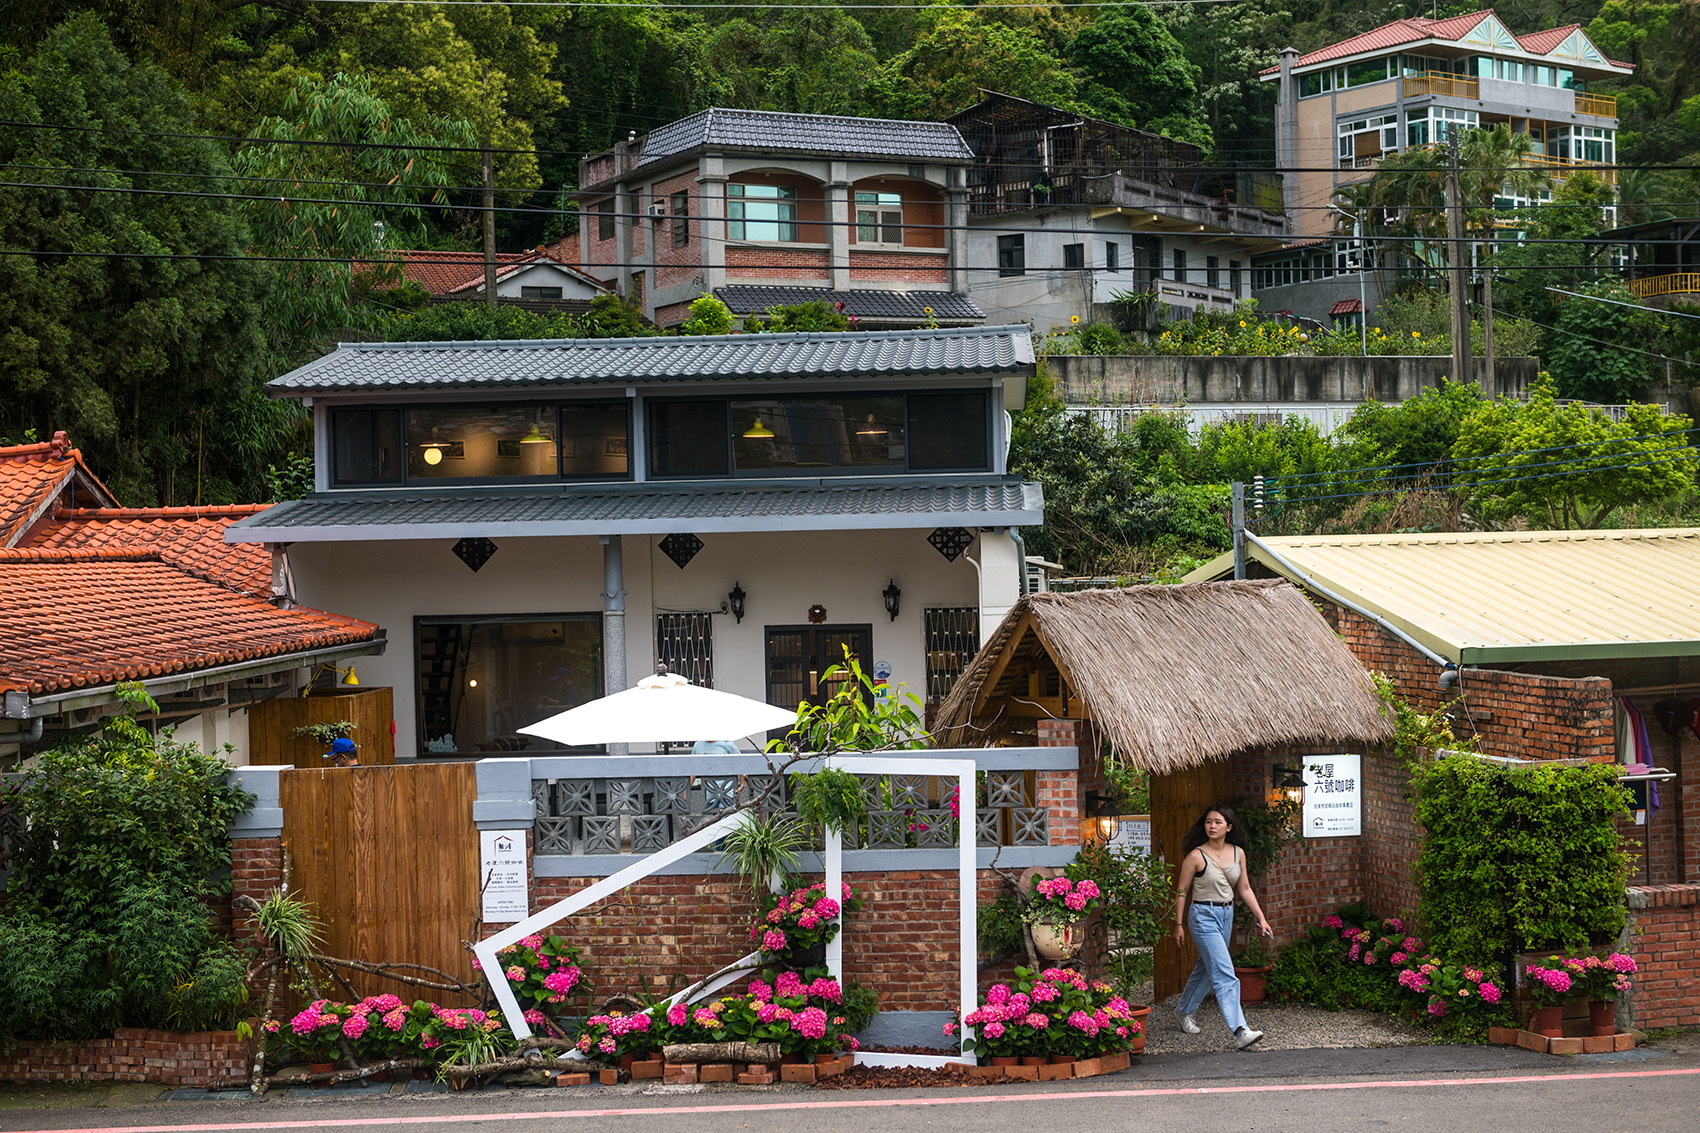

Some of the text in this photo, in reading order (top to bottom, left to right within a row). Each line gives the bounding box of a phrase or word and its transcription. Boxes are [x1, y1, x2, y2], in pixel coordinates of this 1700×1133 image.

[1314, 763, 1334, 778] 老屋
[1314, 778, 1355, 793] 六號咖啡
